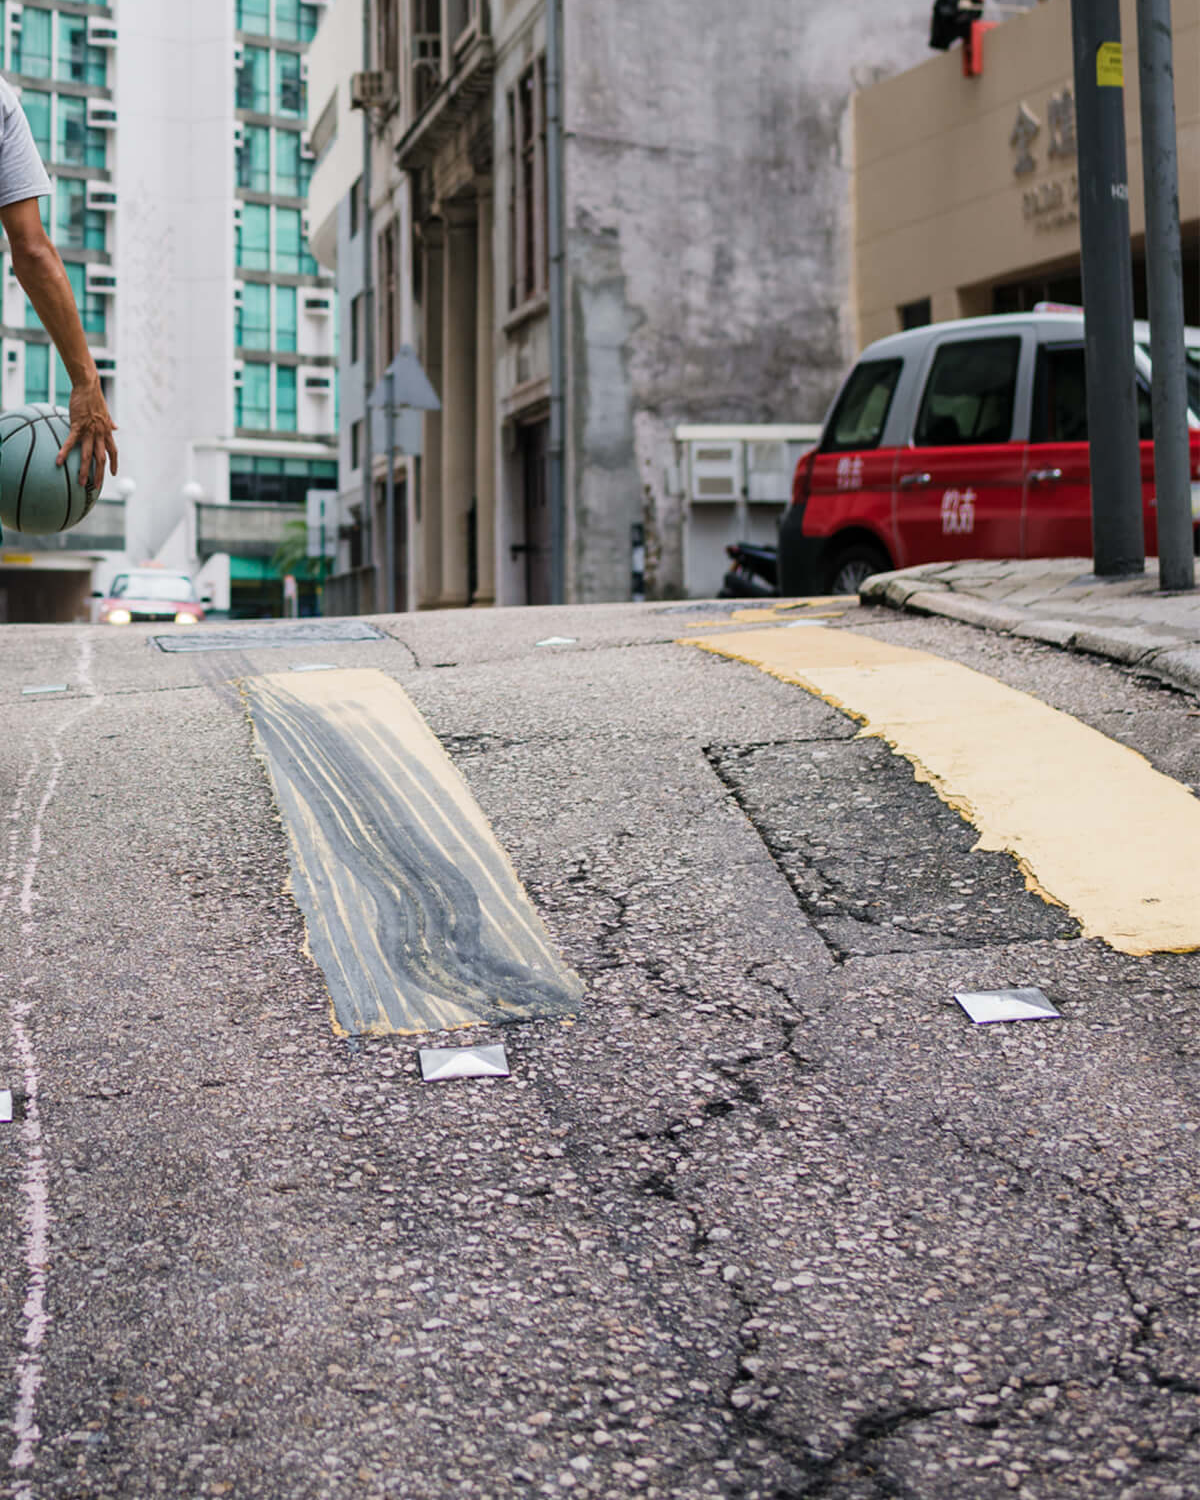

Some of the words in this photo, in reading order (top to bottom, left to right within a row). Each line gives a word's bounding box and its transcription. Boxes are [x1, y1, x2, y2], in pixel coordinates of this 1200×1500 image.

[837, 455, 863, 476] 的士
[942, 488, 976, 508] 的士
[941, 503, 975, 534] TAXI
